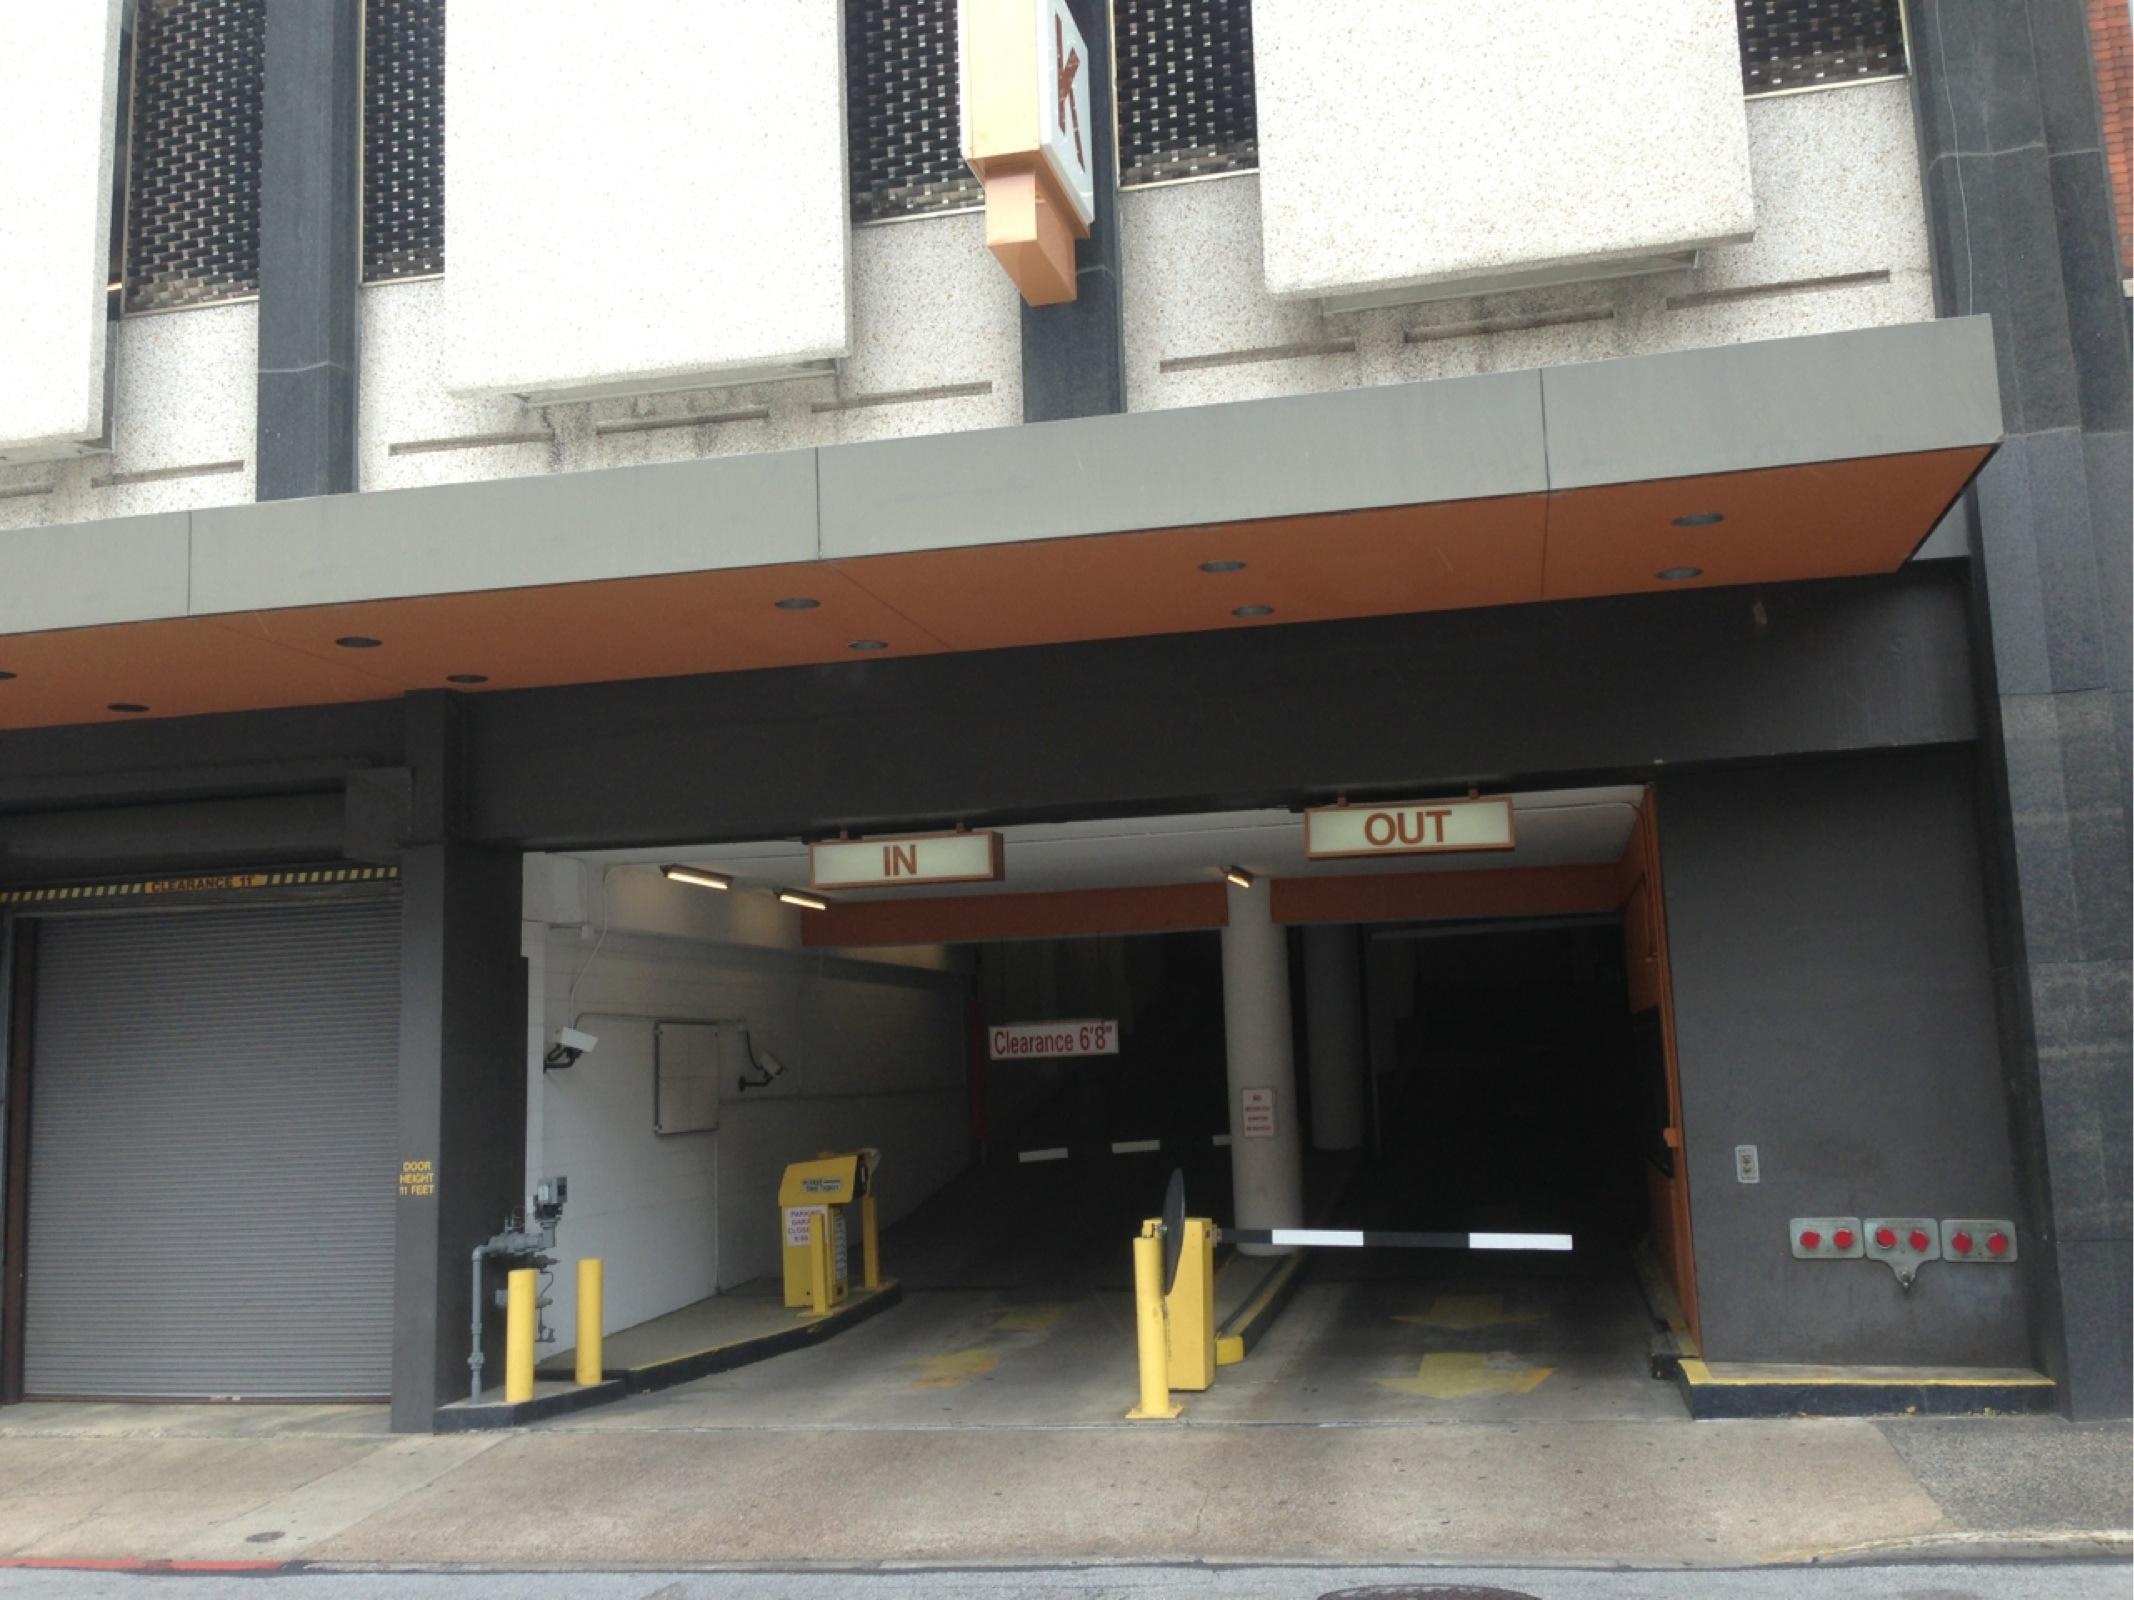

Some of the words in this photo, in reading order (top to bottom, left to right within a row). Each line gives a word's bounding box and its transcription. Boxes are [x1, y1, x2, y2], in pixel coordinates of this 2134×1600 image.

[1054, 12, 1086, 174] K
[1364, 809, 1453, 846] OUT
[883, 844, 918, 876] IN
[151, 876, 233, 893] CLEARANCE
[994, 1030, 1074, 1055] Clearance
[402, 1160, 432, 1172] DOOR
[399, 1172, 434, 1184] HEIGHT
[411, 1184, 435, 1196] FEET
